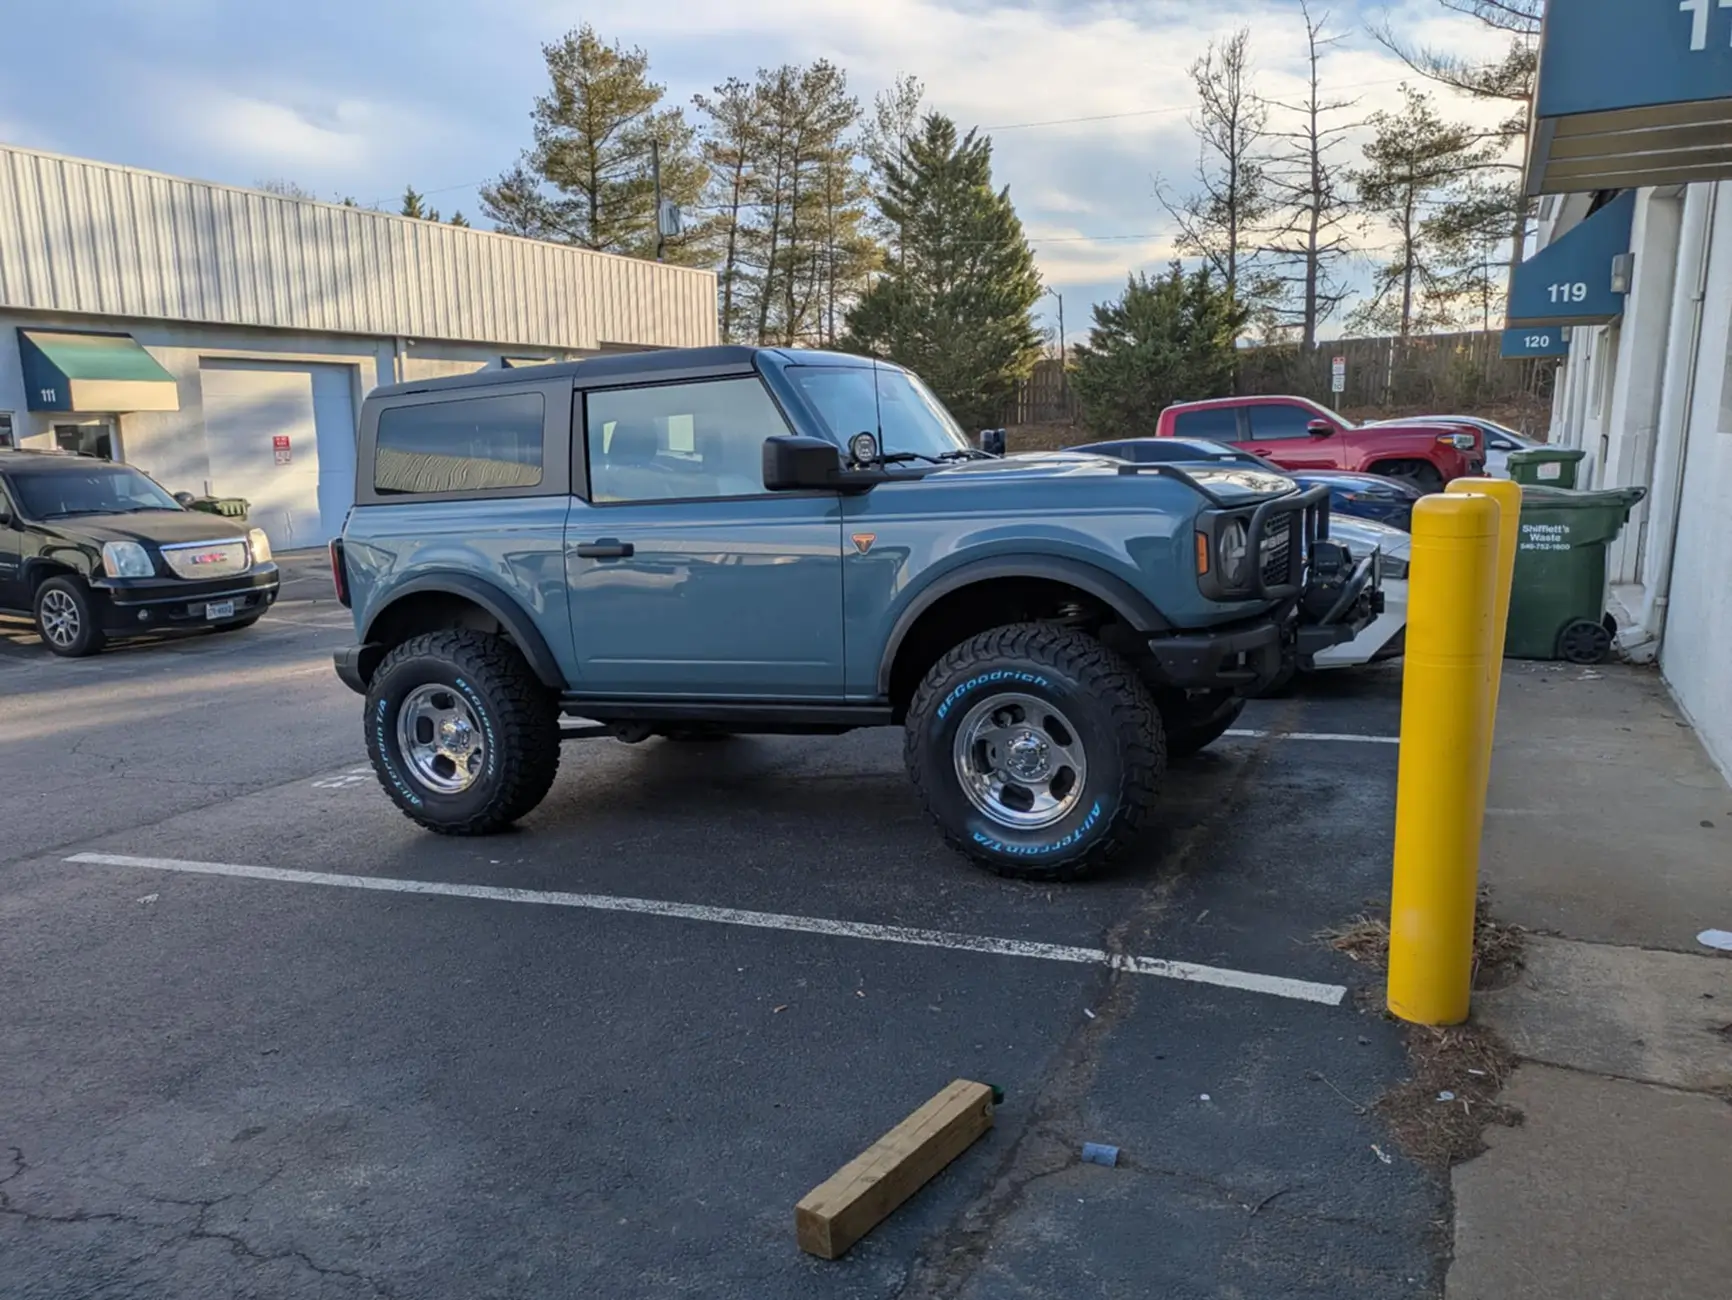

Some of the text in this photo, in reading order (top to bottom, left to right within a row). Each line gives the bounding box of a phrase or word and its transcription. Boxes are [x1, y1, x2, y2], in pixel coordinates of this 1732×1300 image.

[1547, 282, 1588, 302] 119
[1523, 335, 1550, 348] 120
[41, 388, 56, 402] 111
[1530, 533, 1561, 541] Waste
[937, 669, 1049, 719] BFGoodrich
[376, 699, 388, 723] T/A
[455, 677, 495, 775] BFGoodrich
[972, 800, 1101, 855] All-Terrain T/A
